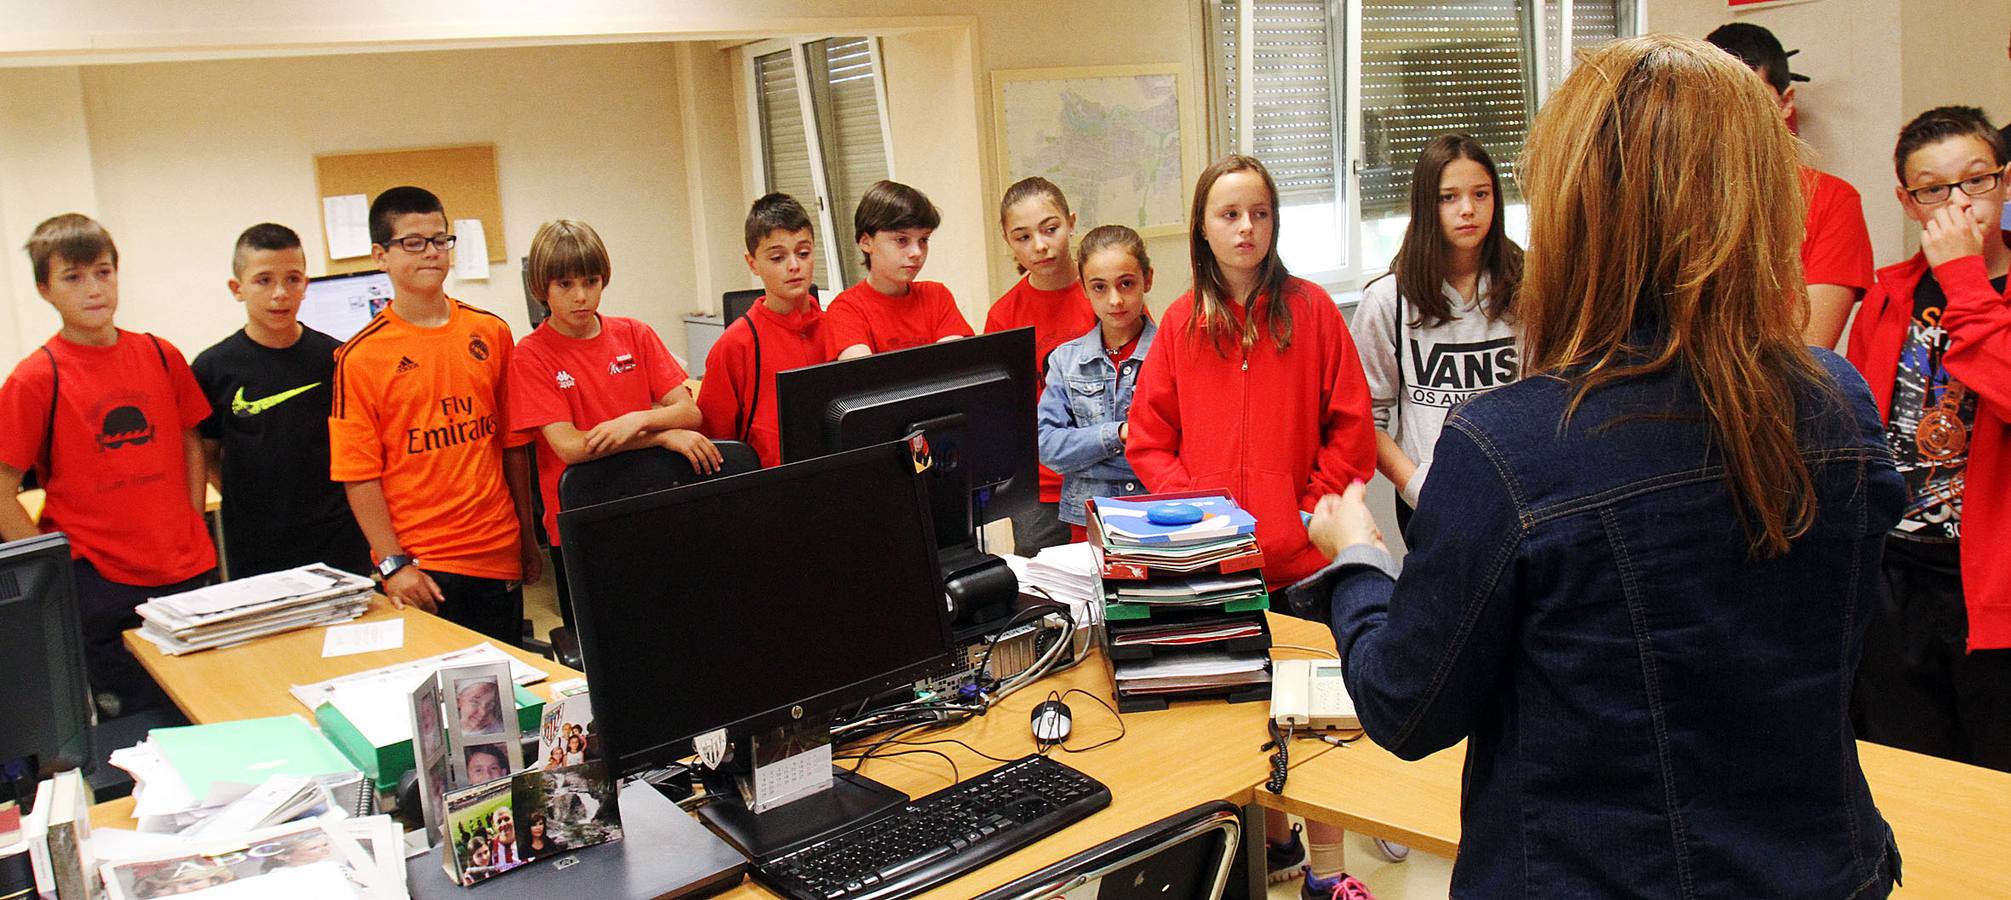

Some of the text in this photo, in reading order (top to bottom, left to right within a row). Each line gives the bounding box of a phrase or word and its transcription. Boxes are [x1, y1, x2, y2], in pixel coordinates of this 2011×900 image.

[1410, 336, 1519, 389] VANS
[440, 396, 472, 416] Fly
[1410, 390, 1435, 404] OS
[407, 414, 497, 454] Emirate
